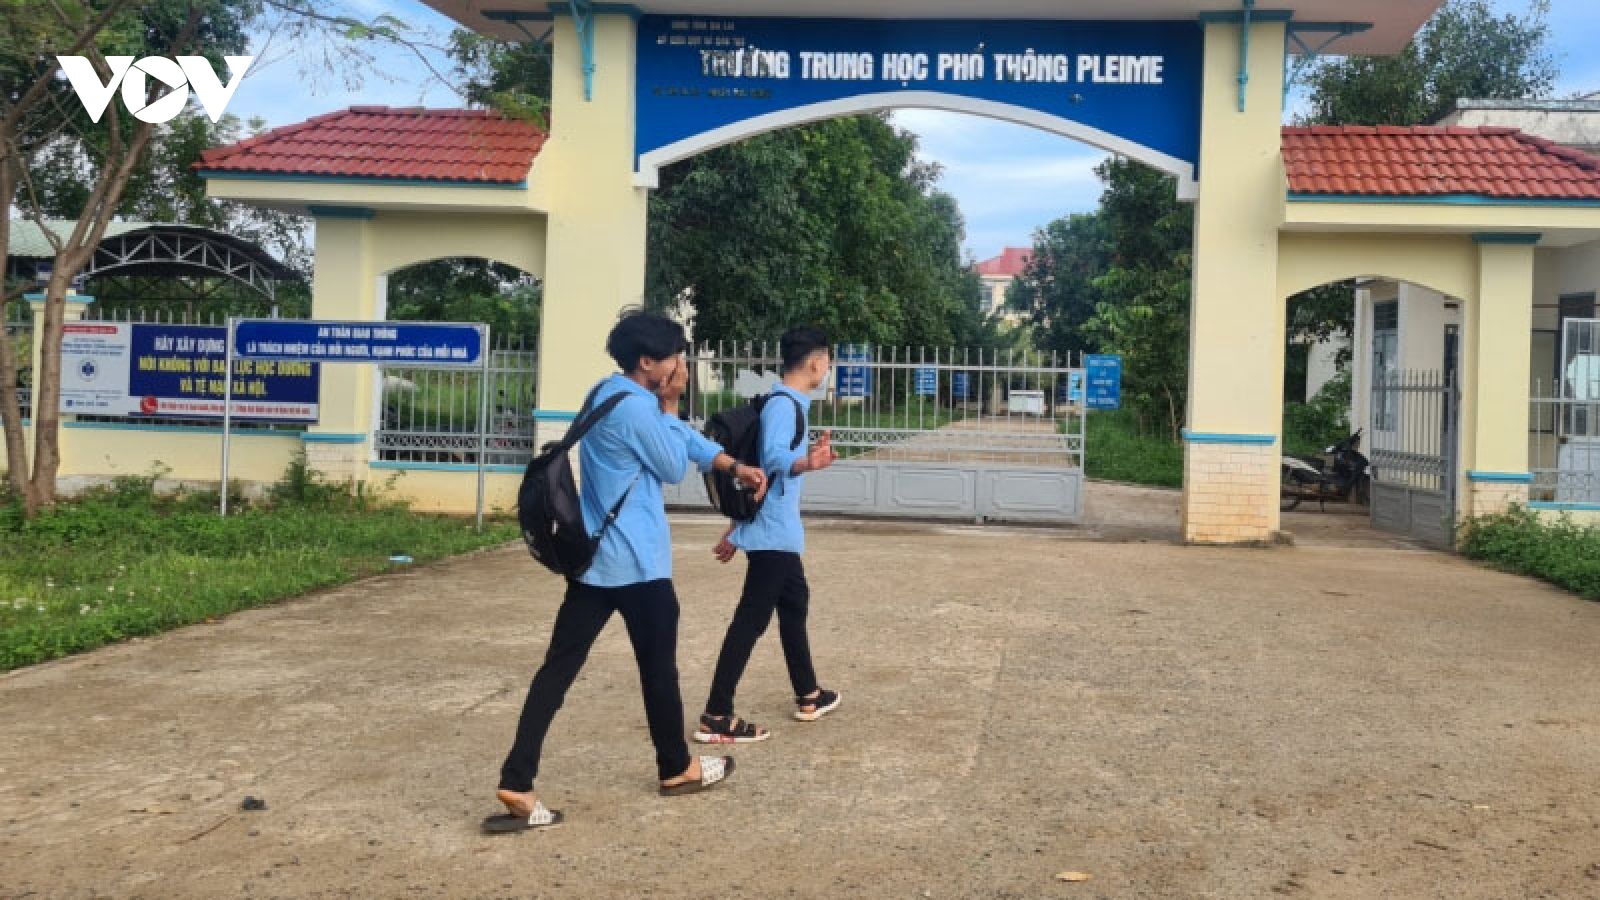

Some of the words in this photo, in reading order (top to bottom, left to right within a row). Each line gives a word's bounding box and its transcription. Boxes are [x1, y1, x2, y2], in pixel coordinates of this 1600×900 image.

[700, 44, 790, 79] TRƯỜNG
[800, 51, 874, 80] TRUNG
[881, 52, 928, 87] HỌC
[993, 47, 1069, 82] THÔNG
[1075, 54, 1165, 84] PLEIME
[318, 326, 329, 338] AN
[155, 334, 174, 352] HÃY
[176, 335, 196, 353] XÂY
[197, 337, 225, 356] DỰNG
[158, 354, 192, 372] KHÔNG
[193, 355, 211, 373] VỚI
[255, 361, 275, 377] HỌC
[180, 376, 193, 392] VÀ
